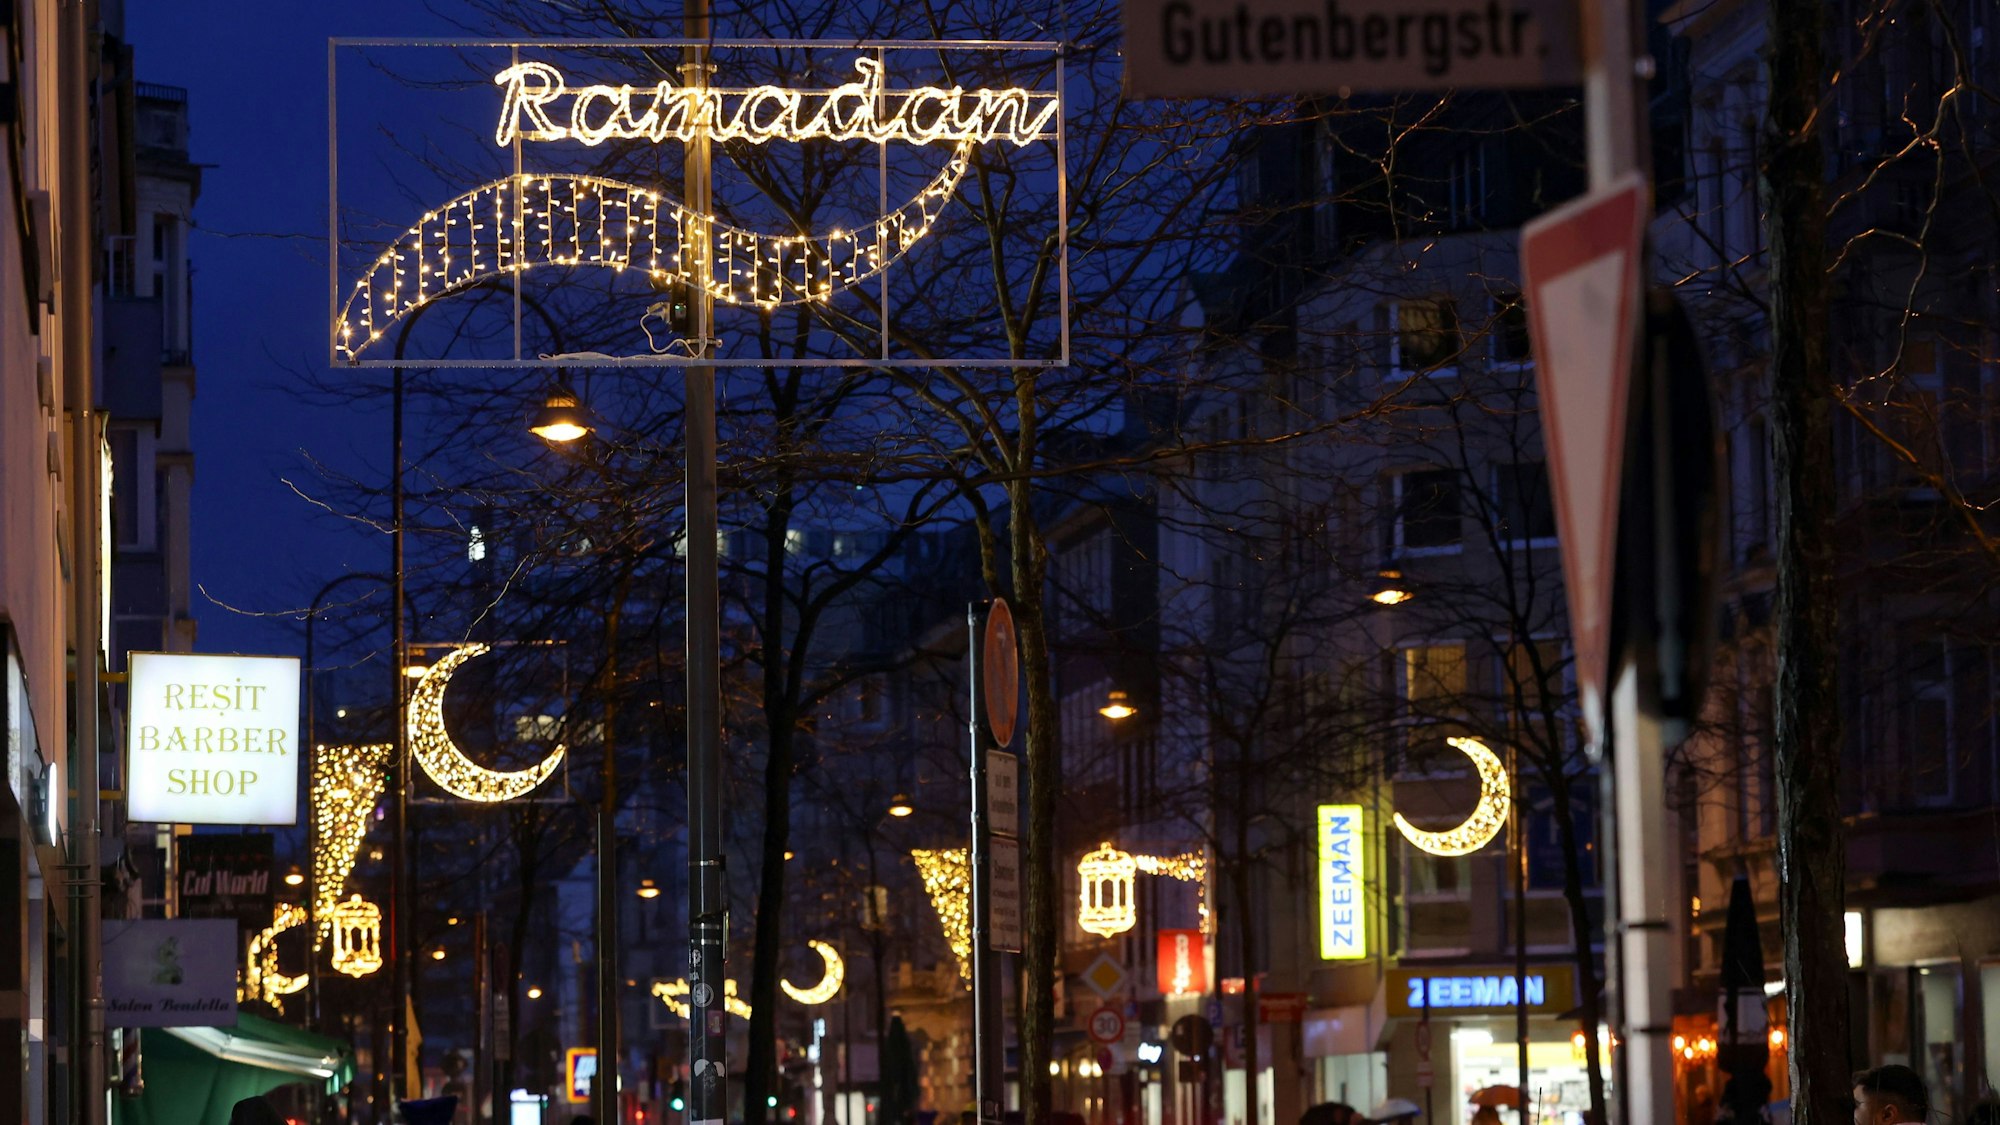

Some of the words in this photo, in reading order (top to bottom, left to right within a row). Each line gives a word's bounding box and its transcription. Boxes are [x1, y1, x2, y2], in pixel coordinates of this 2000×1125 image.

[1160, 0, 1548, 76] Gutenbergstr.
[494, 56, 1059, 147] Ramadan
[138, 726, 290, 756] BARBER
[166, 768, 259, 797] SHOP
[183, 869, 213, 896] Cut
[216, 869, 270, 895] World
[1330, 816, 1353, 946] ZEEMAN
[107, 998, 153, 1012] Salon
[1097, 1017, 1118, 1034] 30
